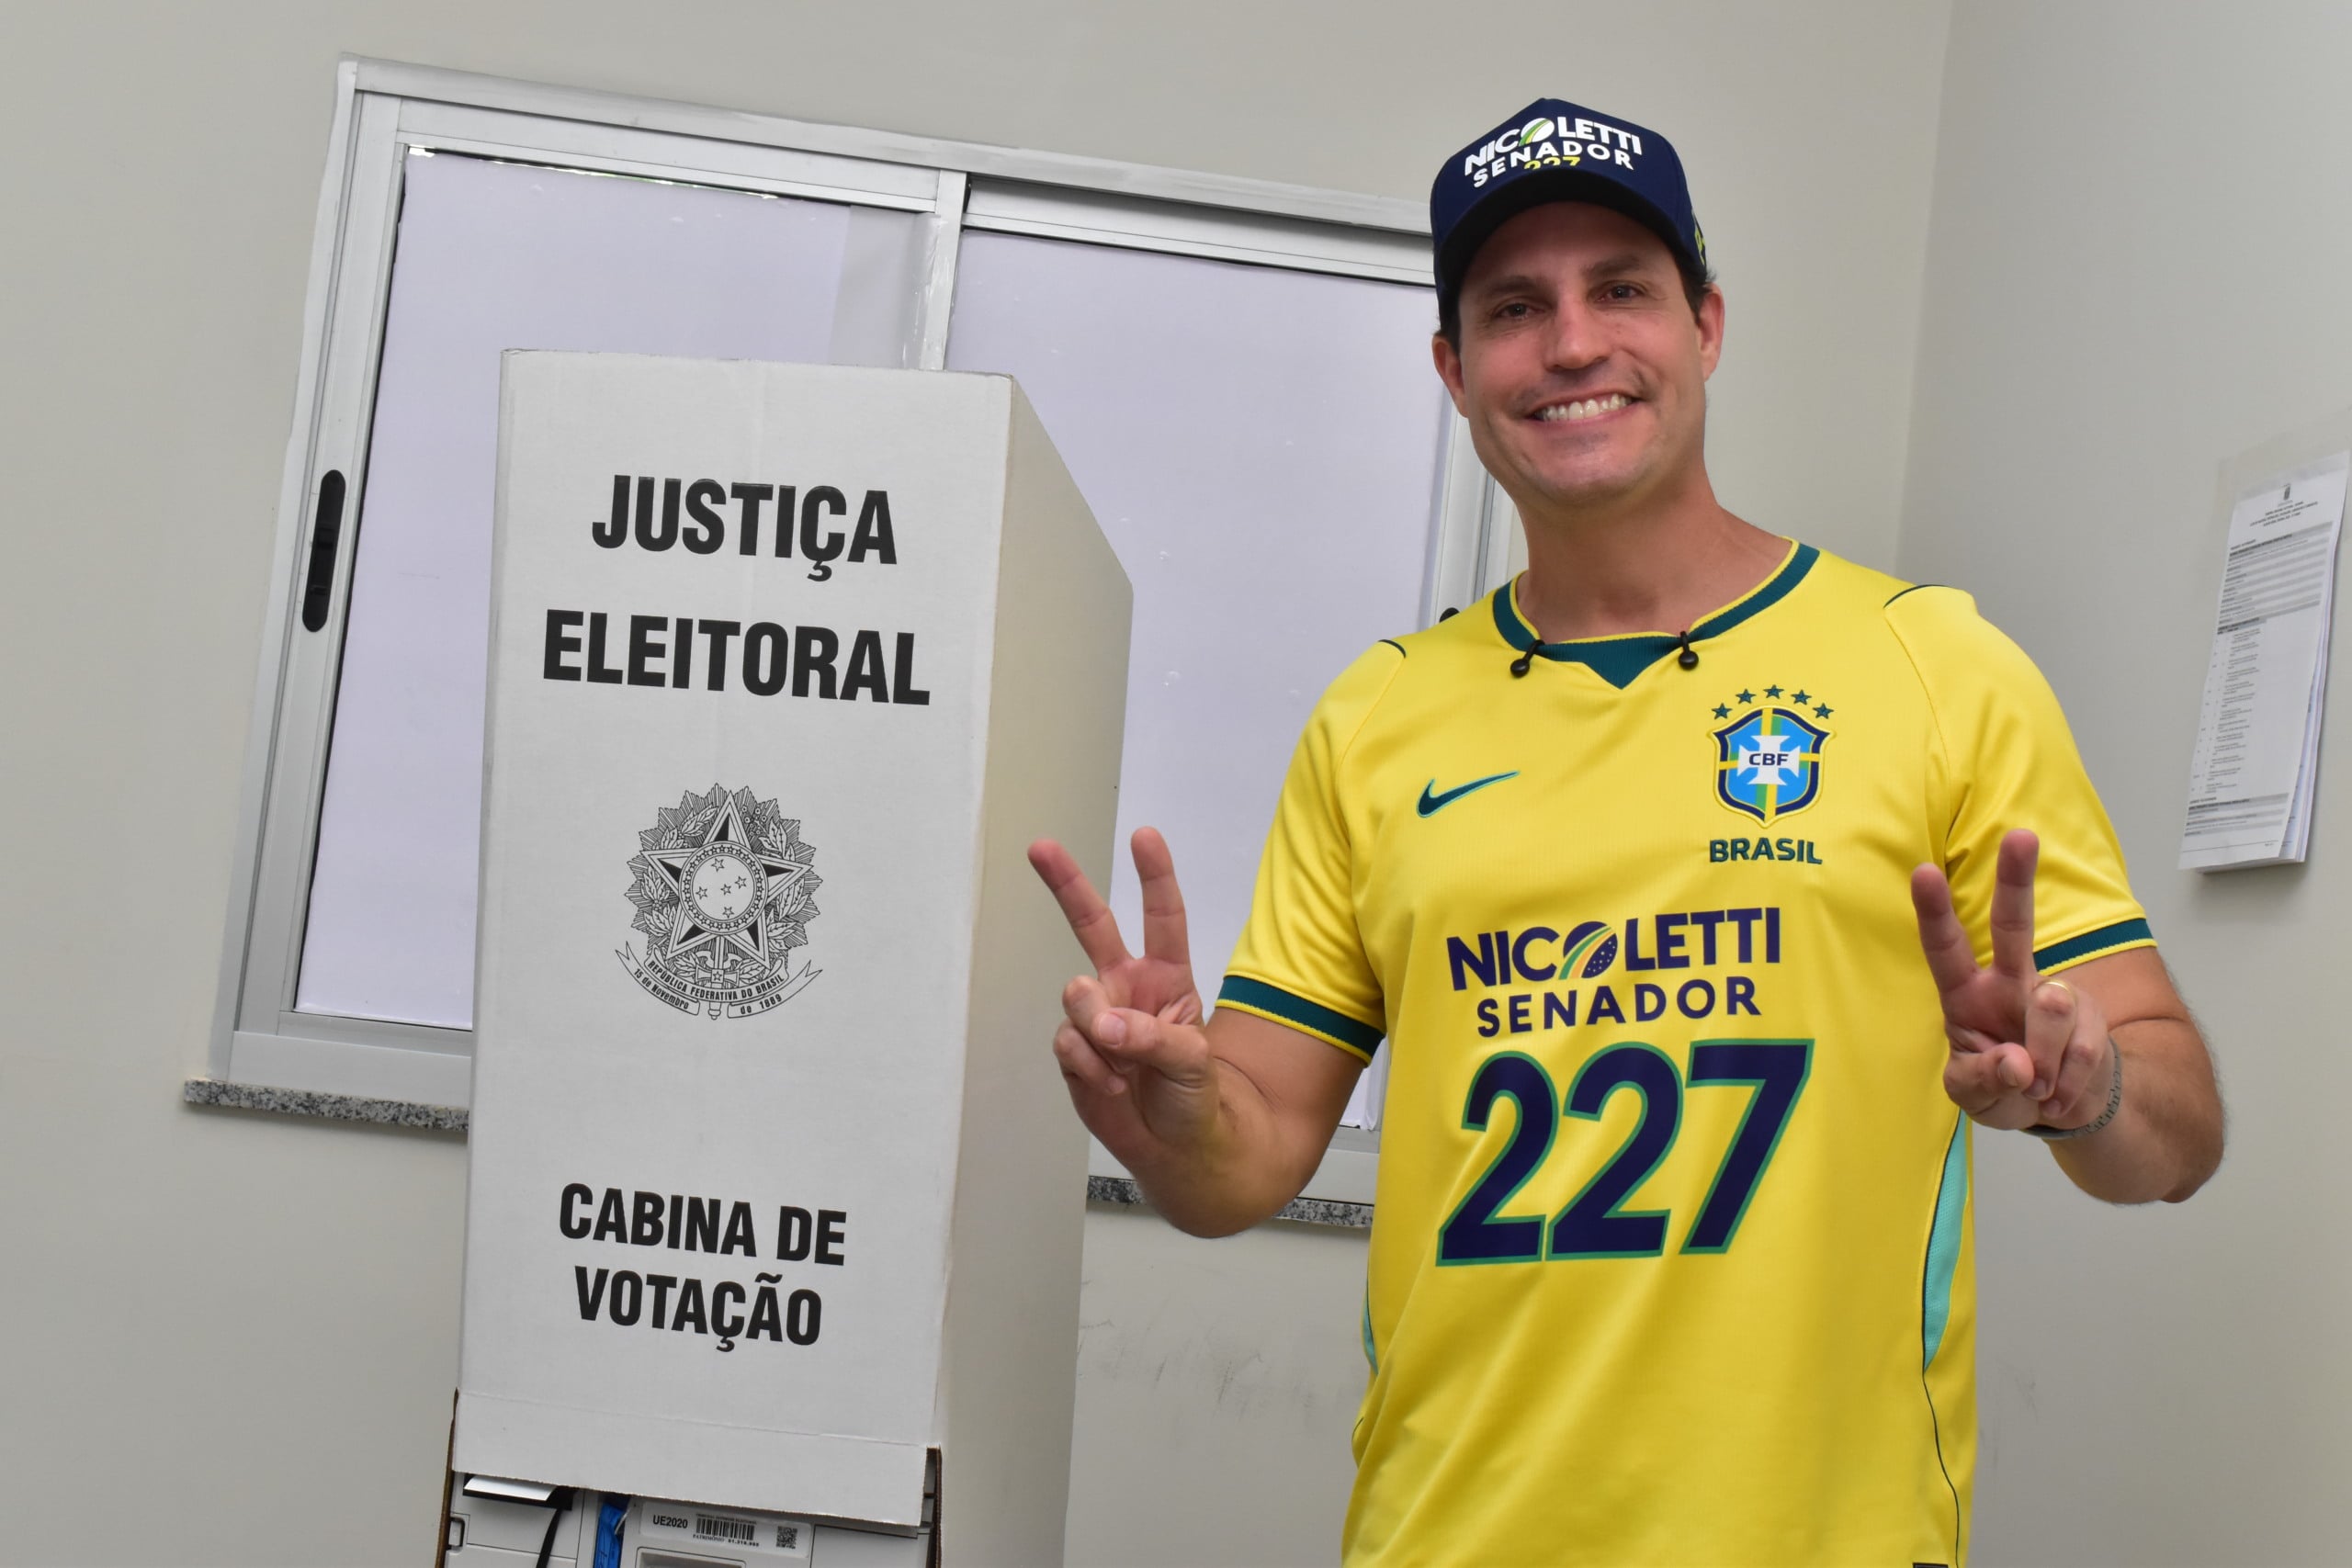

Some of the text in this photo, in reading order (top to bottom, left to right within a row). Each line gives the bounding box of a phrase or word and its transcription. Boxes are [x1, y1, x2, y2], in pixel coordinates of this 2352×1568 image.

[1464, 116, 1643, 176] NICOLETTI
[1473, 140, 1634, 188] SENADOR
[592, 474, 898, 582] JUSTIÇA
[543, 609, 931, 705] ELEITORAL
[1749, 753, 1789, 766] CBF
[1710, 837, 1823, 864] BRASIL
[1446, 907, 1781, 991] NICOLETTI
[634, 968, 643, 979] 15
[641, 976, 652, 988] de
[760, 993, 783, 1010] 1889
[690, 986, 738, 1000] FEDERATIVA
[741, 987, 753, 999] DO
[755, 974, 784, 994] BRASIL
[1476, 976, 1762, 1037] SENADOR
[1435, 1038, 1815, 1267] 227
[560, 1182, 847, 1266] CABINA DE
[574, 1265, 822, 1353] VOTAÇÃO
[653, 1515, 688, 1529] UE2020
